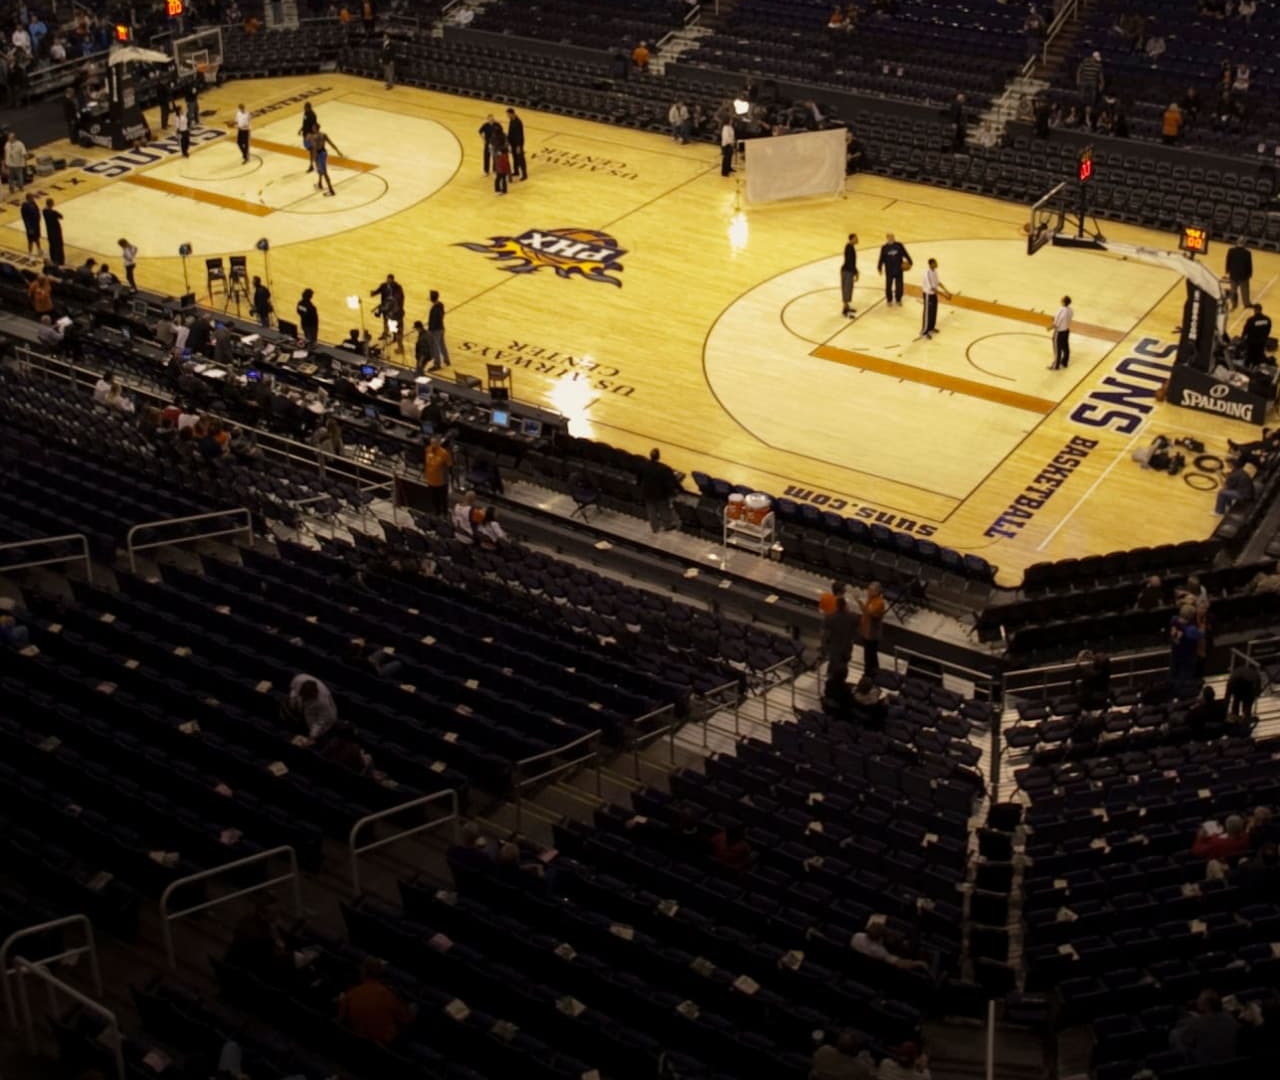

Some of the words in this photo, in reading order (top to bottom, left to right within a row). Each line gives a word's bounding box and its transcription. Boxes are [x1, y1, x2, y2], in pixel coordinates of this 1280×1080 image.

[519, 231, 615, 263] PHX
[593, 378, 637, 398] US
[1070, 336, 1181, 435] SUNS
[1180, 388, 1255, 422] SPALDING
[983, 434, 1101, 540] BASKETBALL
[783, 484, 940, 538] suns.com
